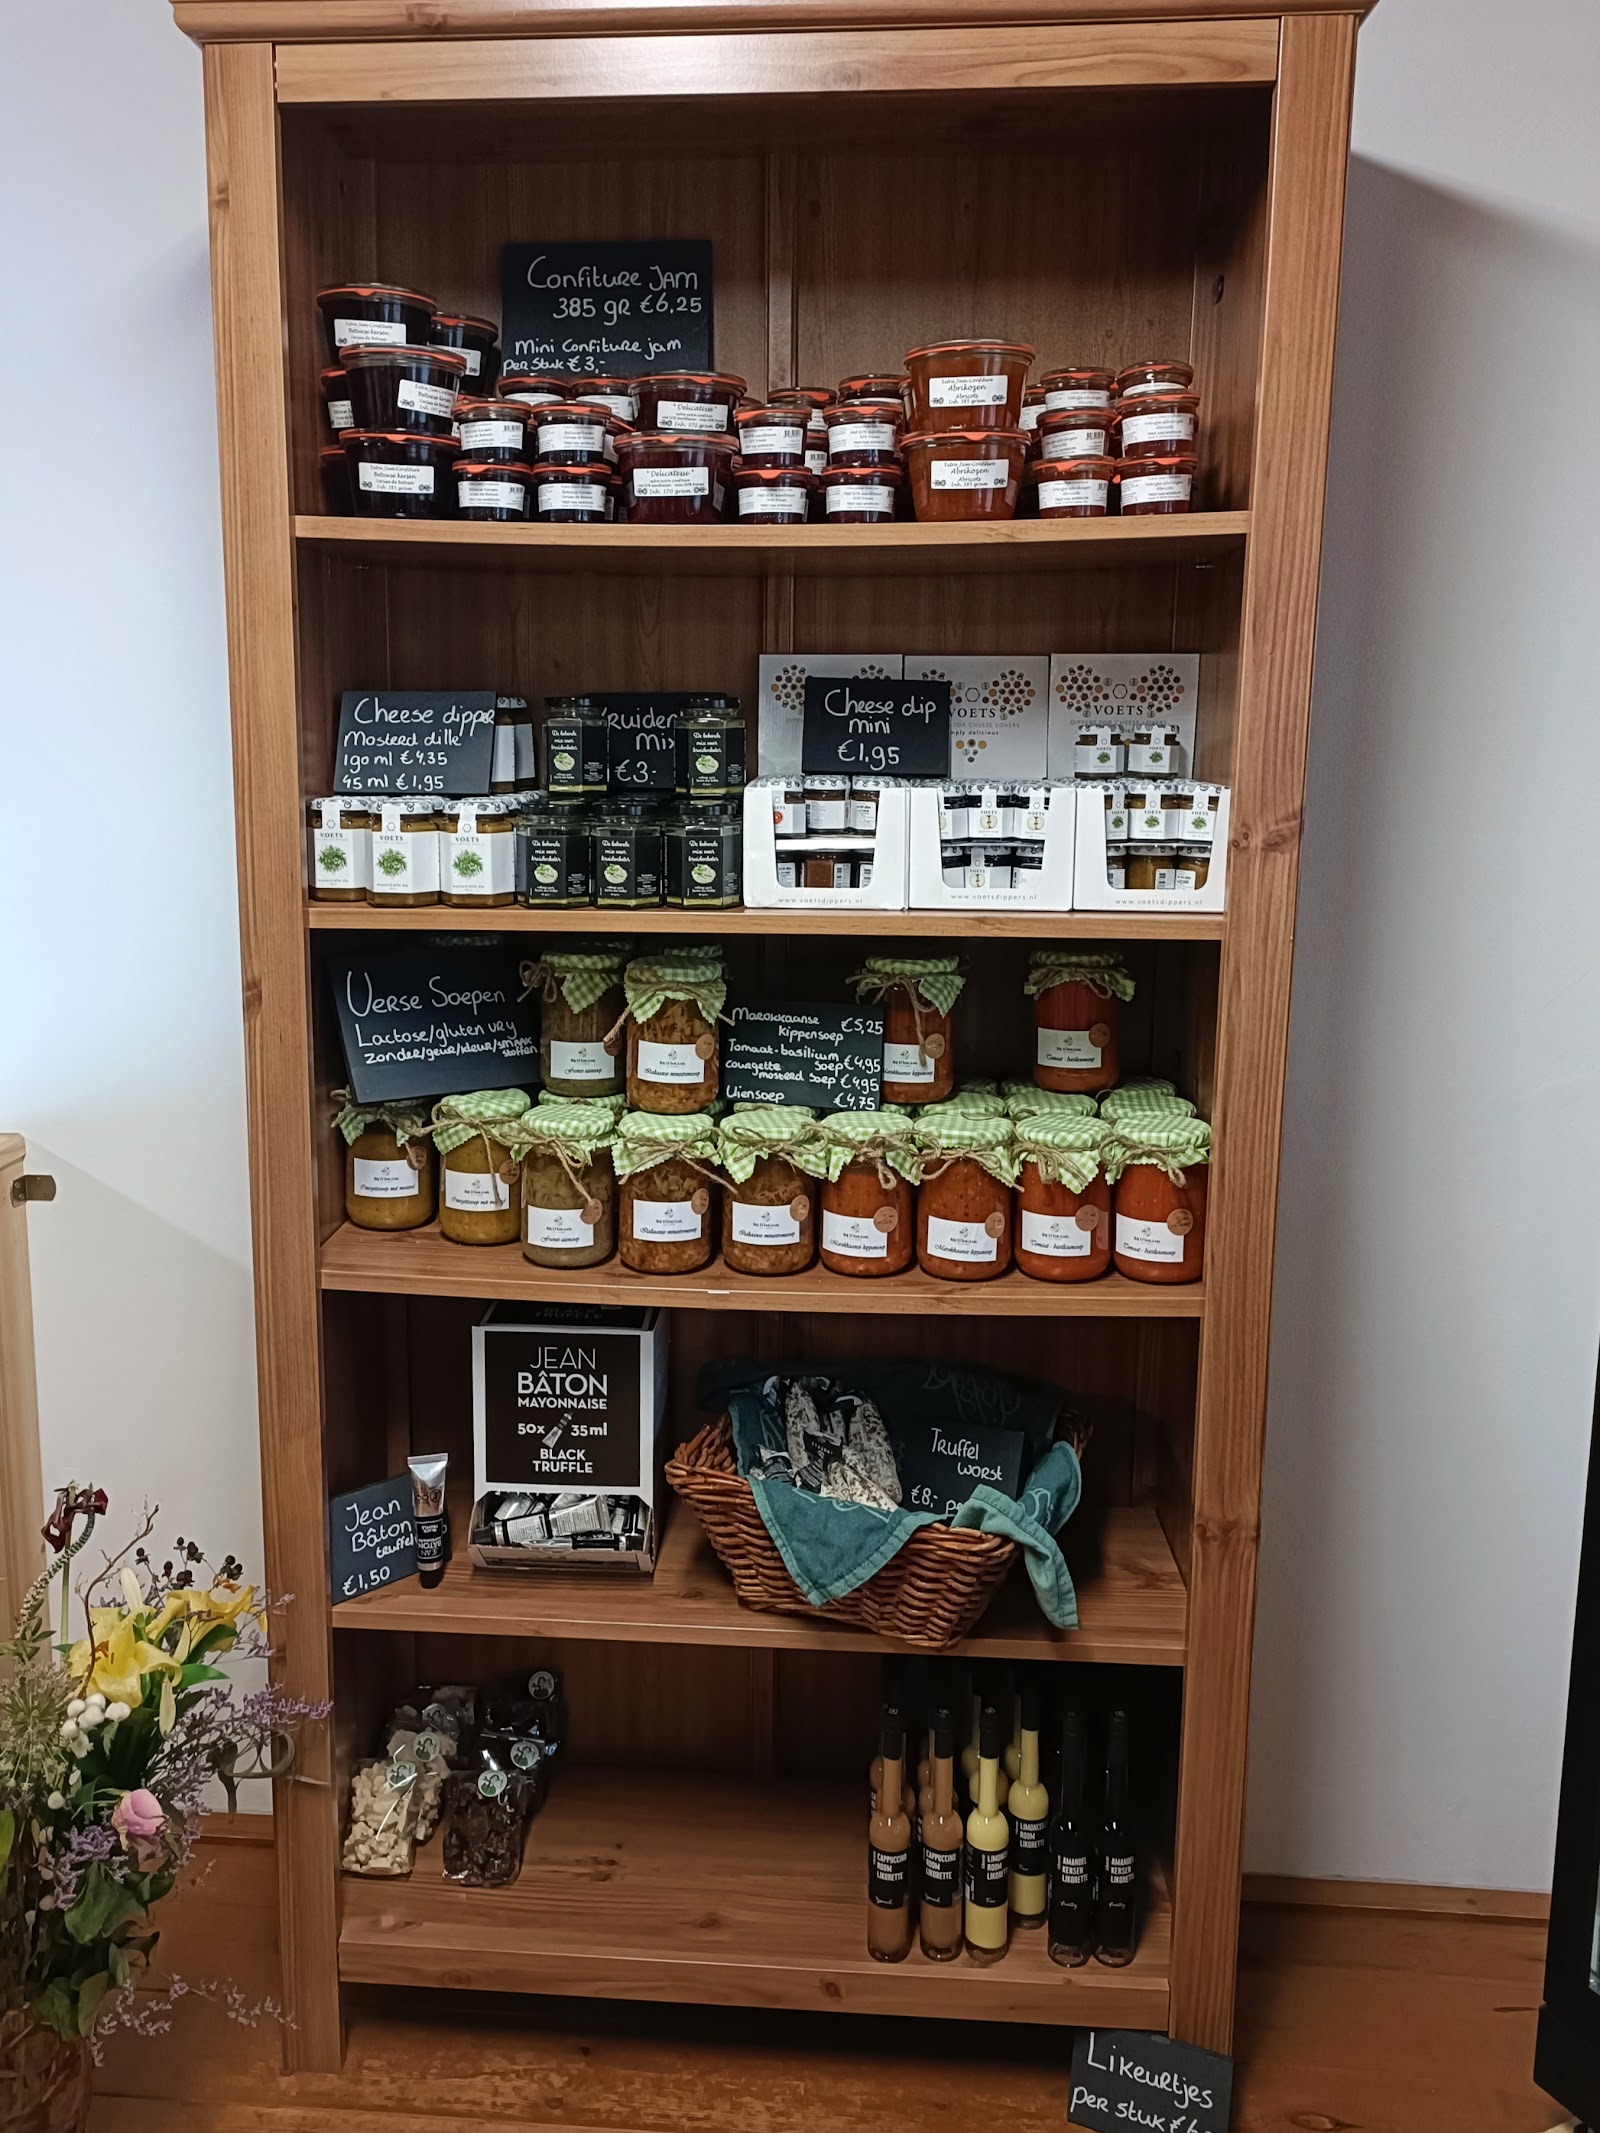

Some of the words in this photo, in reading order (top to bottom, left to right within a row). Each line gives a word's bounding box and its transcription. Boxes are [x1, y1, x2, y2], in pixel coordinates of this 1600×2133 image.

[552, 298, 597, 319] 385
[354, 697, 434, 724] Cheese
[825, 687, 894, 717] Cheese
[902, 695, 937, 724] dip
[1094, 705, 1144, 716] VOETS
[424, 729, 463, 747] dille
[374, 752, 393, 767] ml
[342, 774, 363, 790] 45
[367, 774, 389, 789] ml
[778, 896, 864, 905] www.voetsdippers.nl
[951, 893, 1037, 901] www.voetsdippers.nl
[1115, 898, 1203, 906] www.voetsdippers.nl
[428, 975, 506, 1015] Soepen
[355, 1022, 485, 1047] Lactose/gluten
[529, 1346, 596, 1371] JEAN
[517, 1371, 608, 1397] BÂTON
[517, 1397, 607, 1410] MAYONNAISE
[517, 1422, 545, 1435] 50x
[931, 1427, 979, 1460] Truffel
[540, 1448, 586, 1461] BLACK
[532, 1460, 593, 1474] TRUFFLE
[957, 1462, 1003, 1481] worst
[345, 1499, 401, 1532] Jean
[351, 1520, 412, 1552] Bâton
[1019, 1830, 1036, 1840] ROOM
[876, 1852, 907, 1864] CAPPUCCINO
[925, 1849, 957, 1863] CAPPUCCINO
[1062, 1856, 1088, 1866] AMANDEL
[876, 1861, 893, 1873] ROOM
[925, 1858, 941, 1871] ROOM
[986, 1861, 1003, 1872] ROOM
[1062, 1865, 1084, 1875] KERSEN
[1110, 1864, 1132, 1875] KERSEN
[876, 1870, 904, 1882] LIKORETTE
[925, 1867, 953, 1880] LIKORETTE
[1087, 2031, 1214, 2109] Likeurtjes
